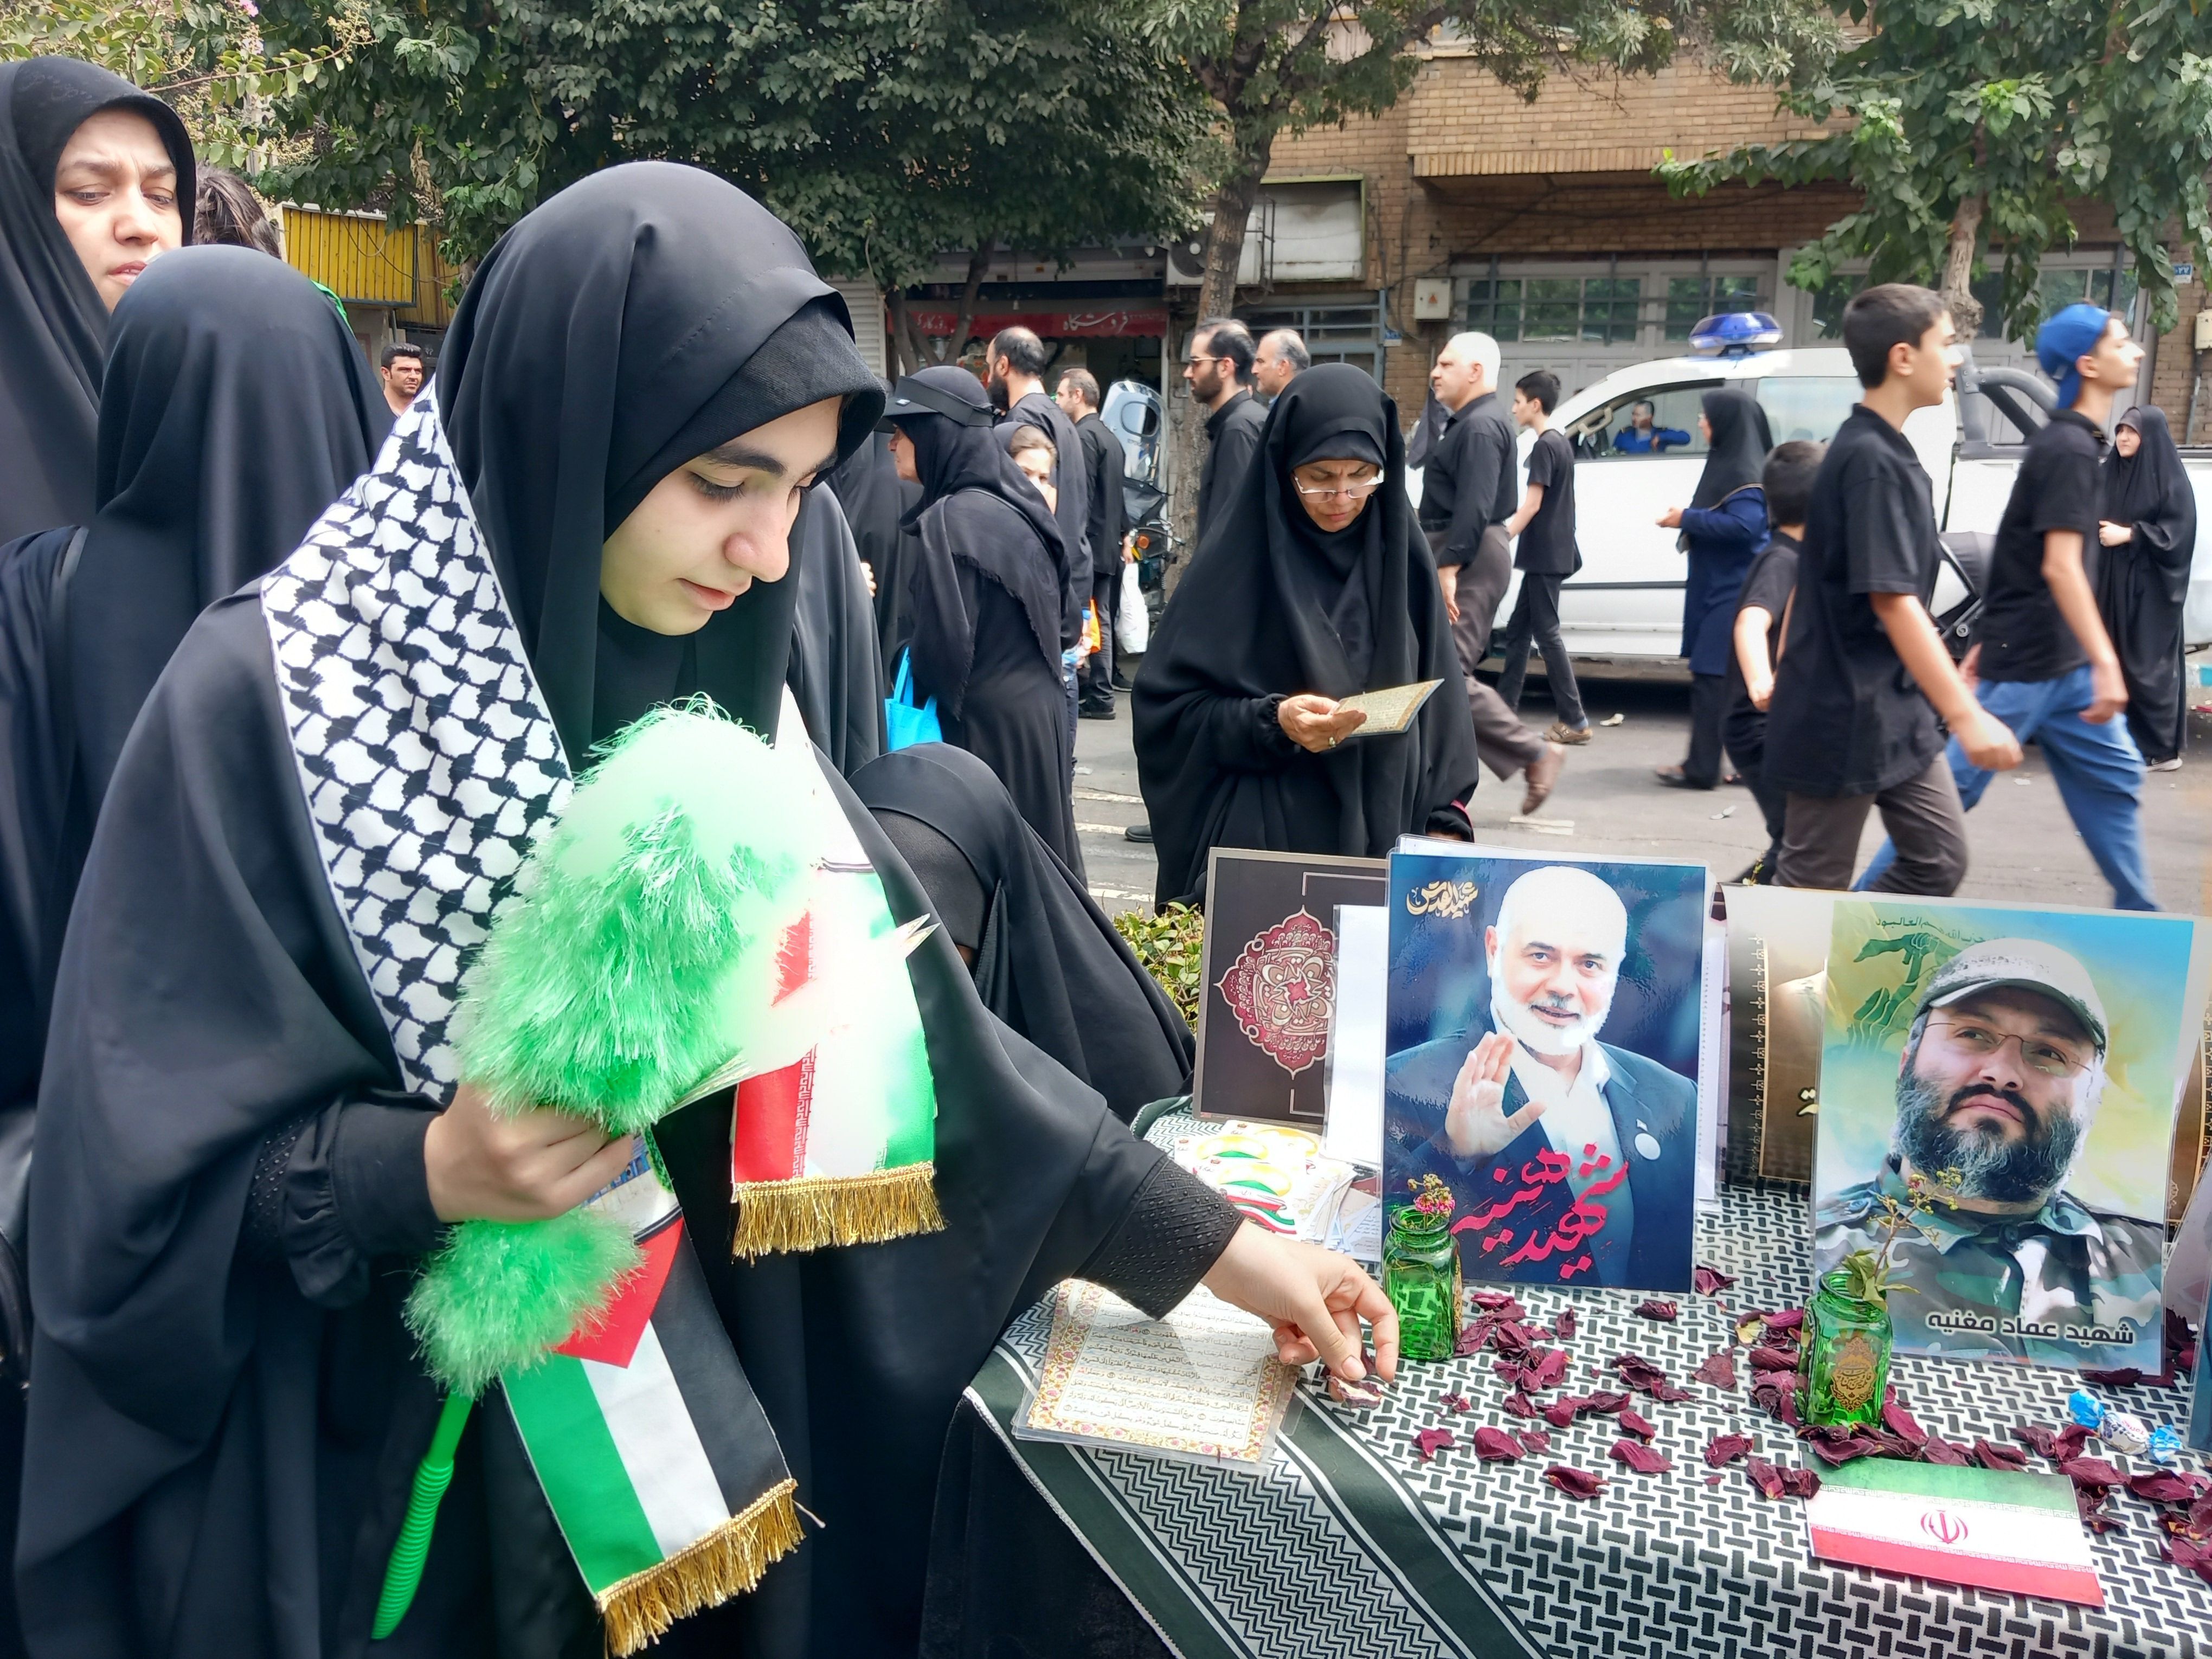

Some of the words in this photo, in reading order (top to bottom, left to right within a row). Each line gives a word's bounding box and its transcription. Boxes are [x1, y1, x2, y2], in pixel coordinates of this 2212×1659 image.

[1926, 1310, 1995, 1334] مغنیه
[2001, 1316, 2060, 1340] عماد
[2064, 1321, 2134, 1346] شهید
